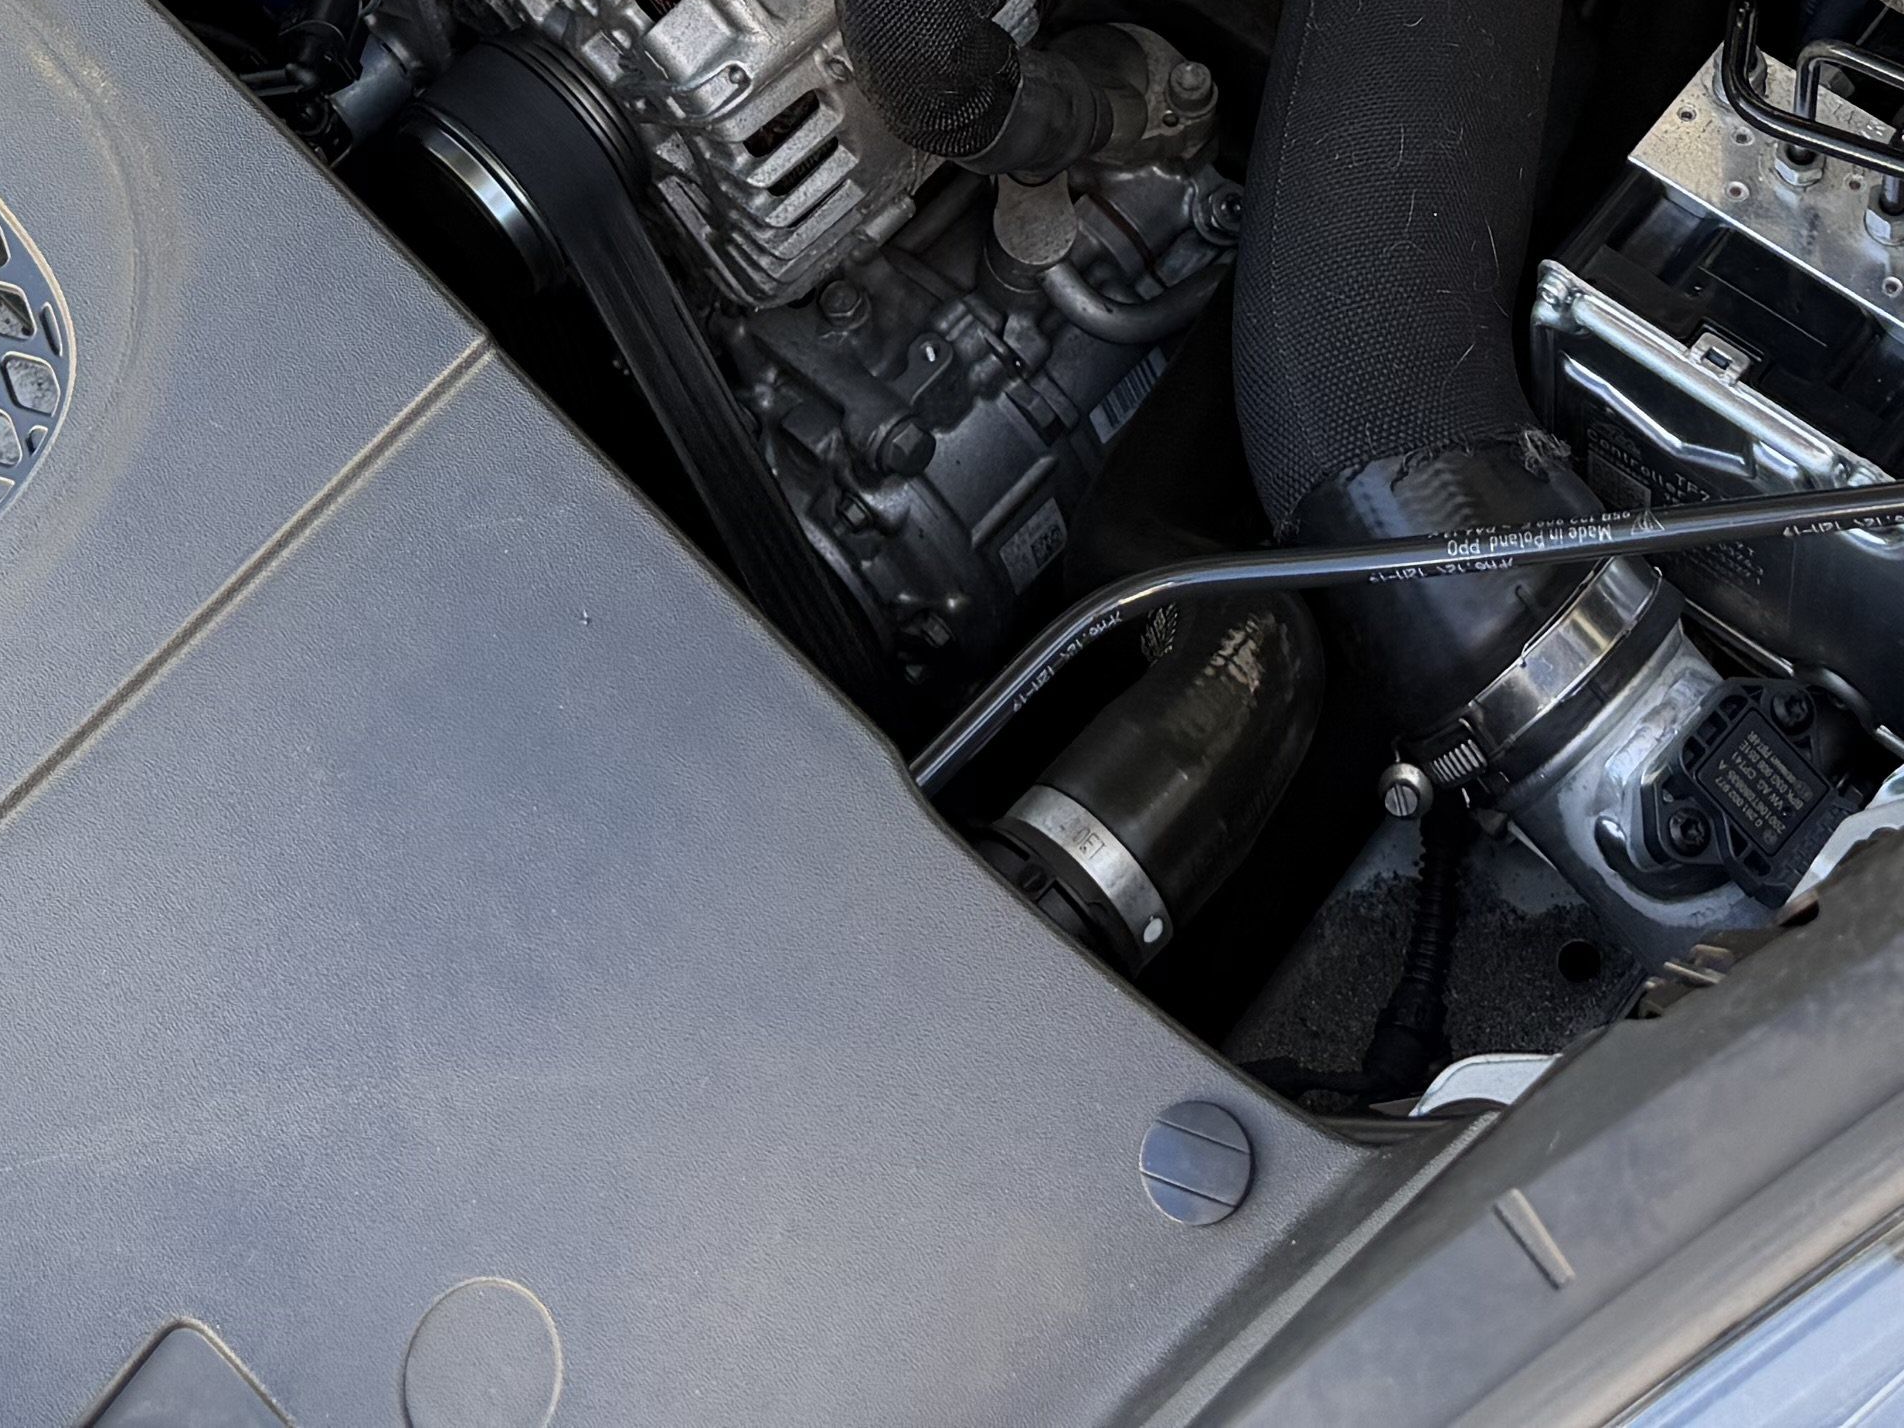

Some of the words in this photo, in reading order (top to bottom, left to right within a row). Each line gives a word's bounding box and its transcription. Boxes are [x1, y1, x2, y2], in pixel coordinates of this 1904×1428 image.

[1491, 530, 1546, 553] Poland
[1548, 530, 1564, 547] in
[1575, 524, 1614, 545] Made
[1768, 793, 1784, 810] VW
